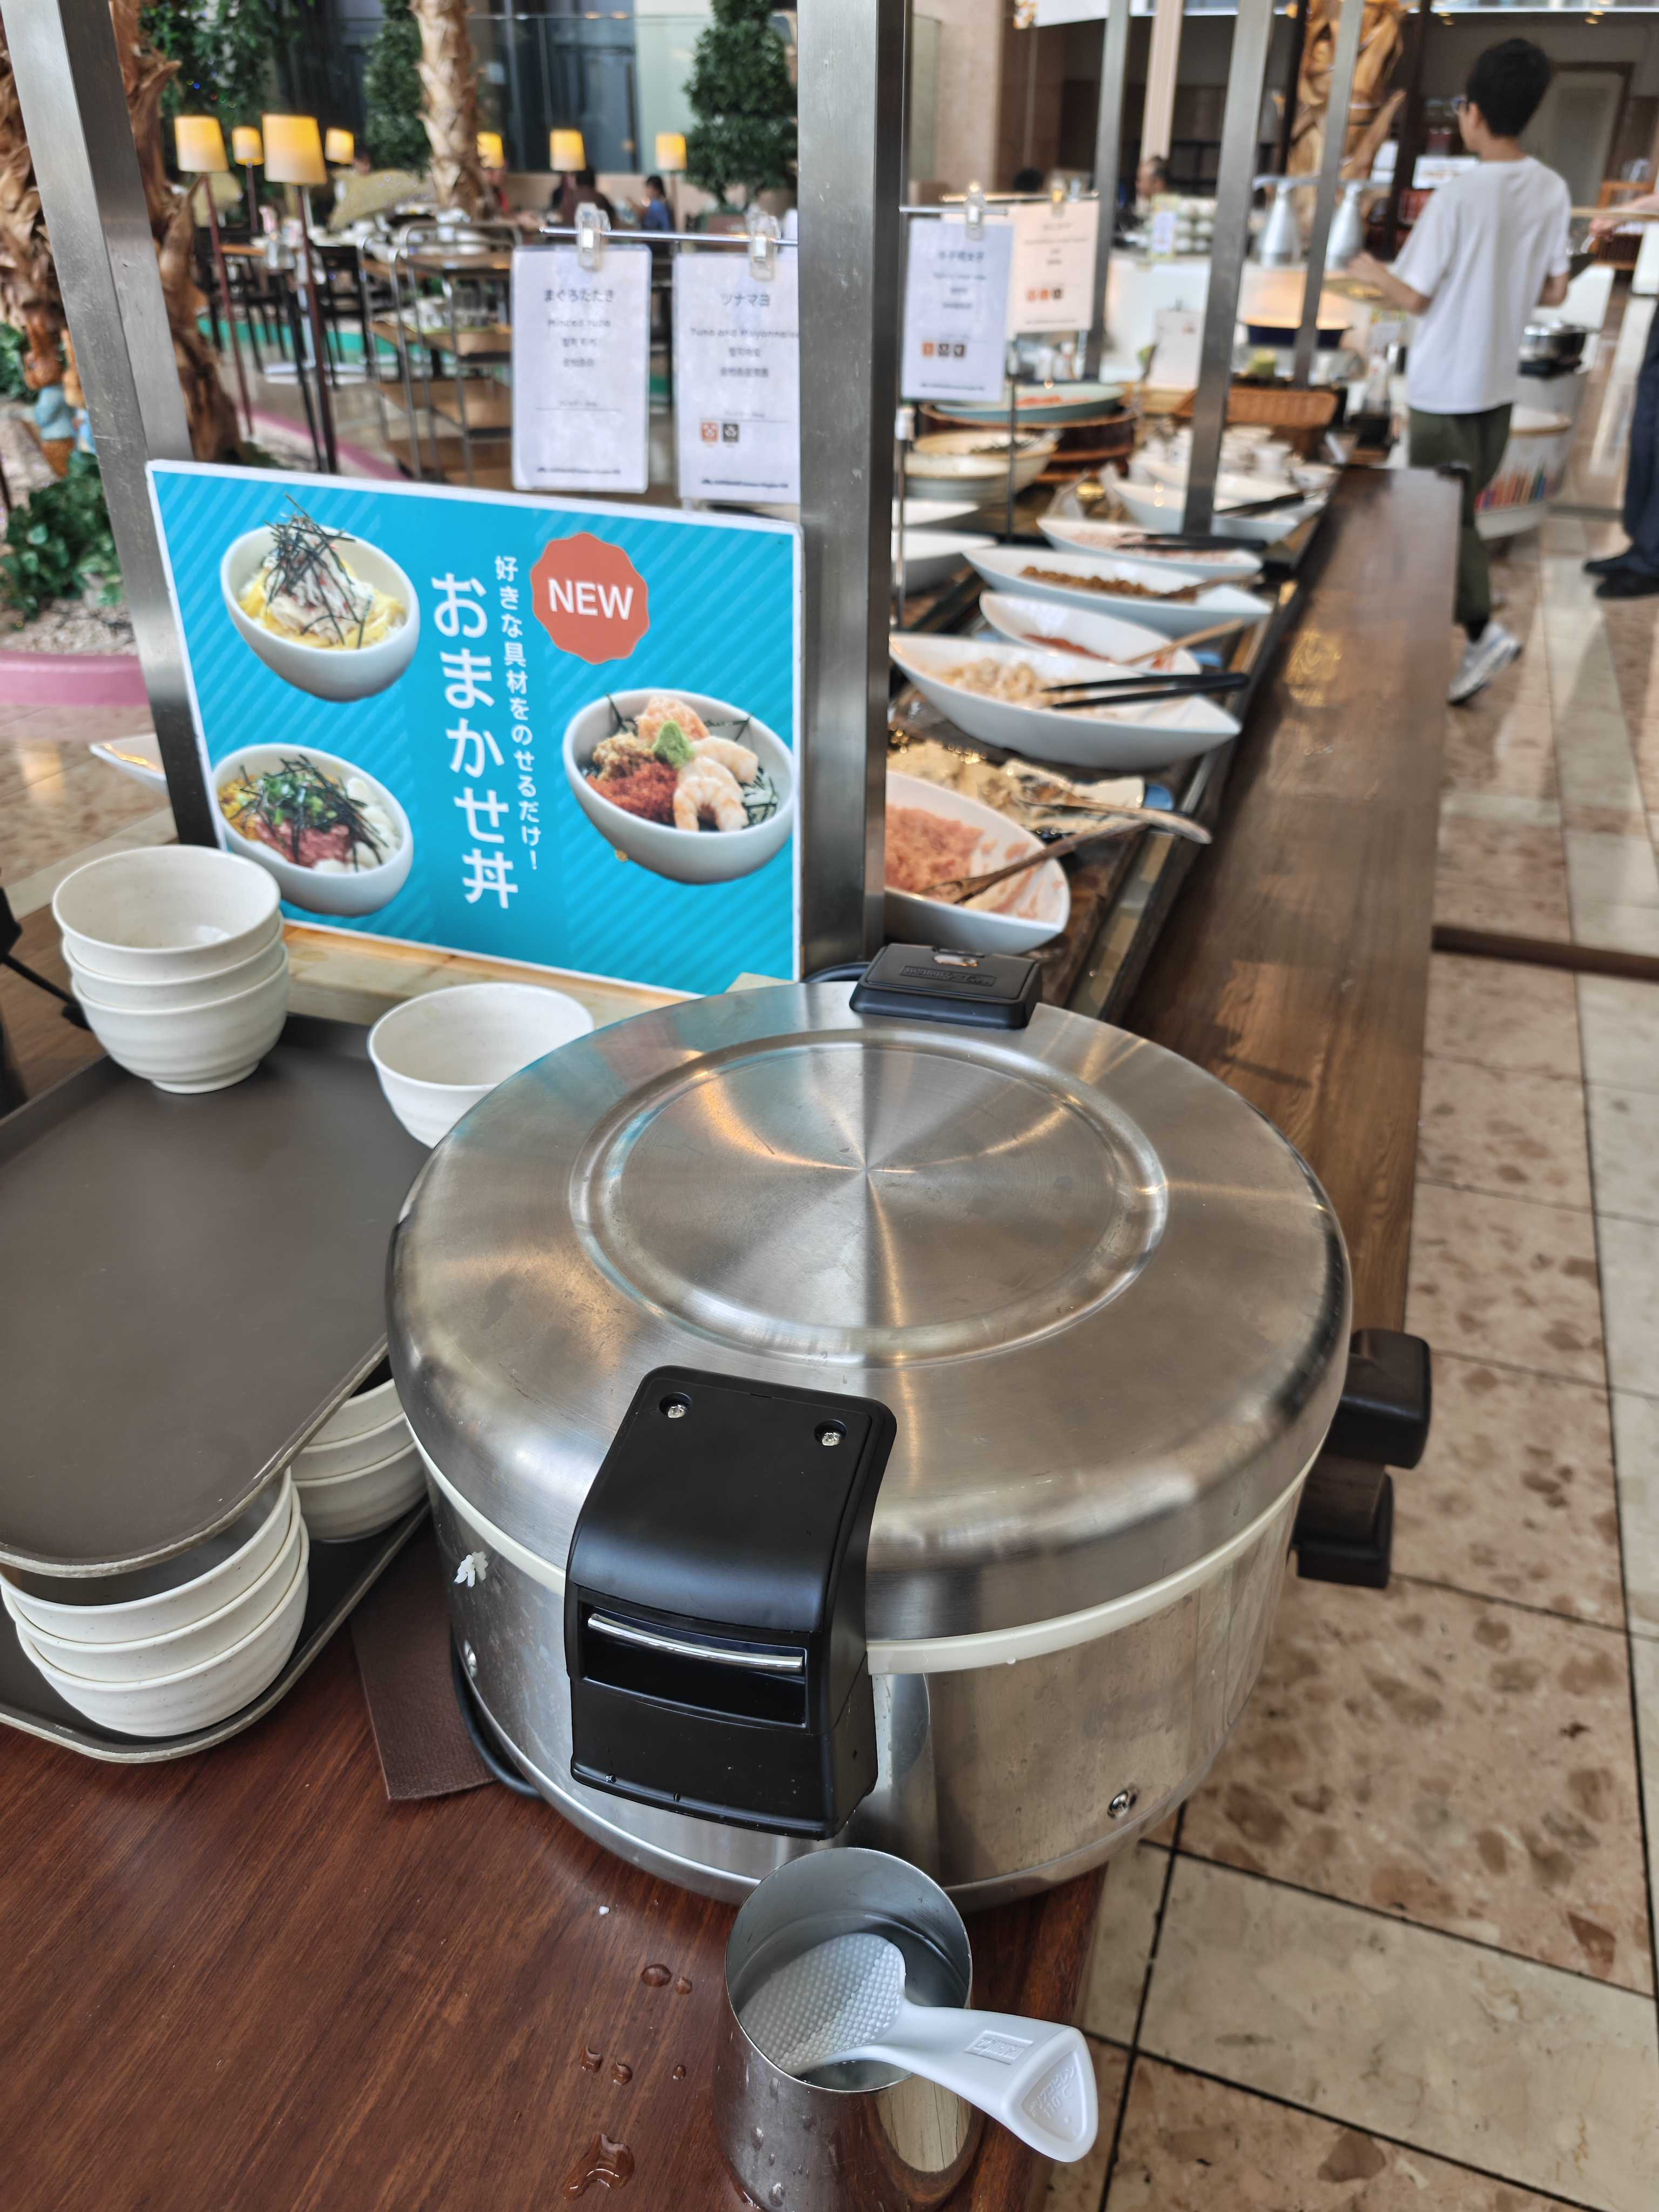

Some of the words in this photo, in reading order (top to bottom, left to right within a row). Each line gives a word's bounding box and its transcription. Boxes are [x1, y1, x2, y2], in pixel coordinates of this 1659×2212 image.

[544, 288, 614, 302] まぐろたたき
[720, 294, 770, 306] ツナマヨ
[547, 578, 633, 621] NEW
[431, 572, 519, 909] おまかせ丼
